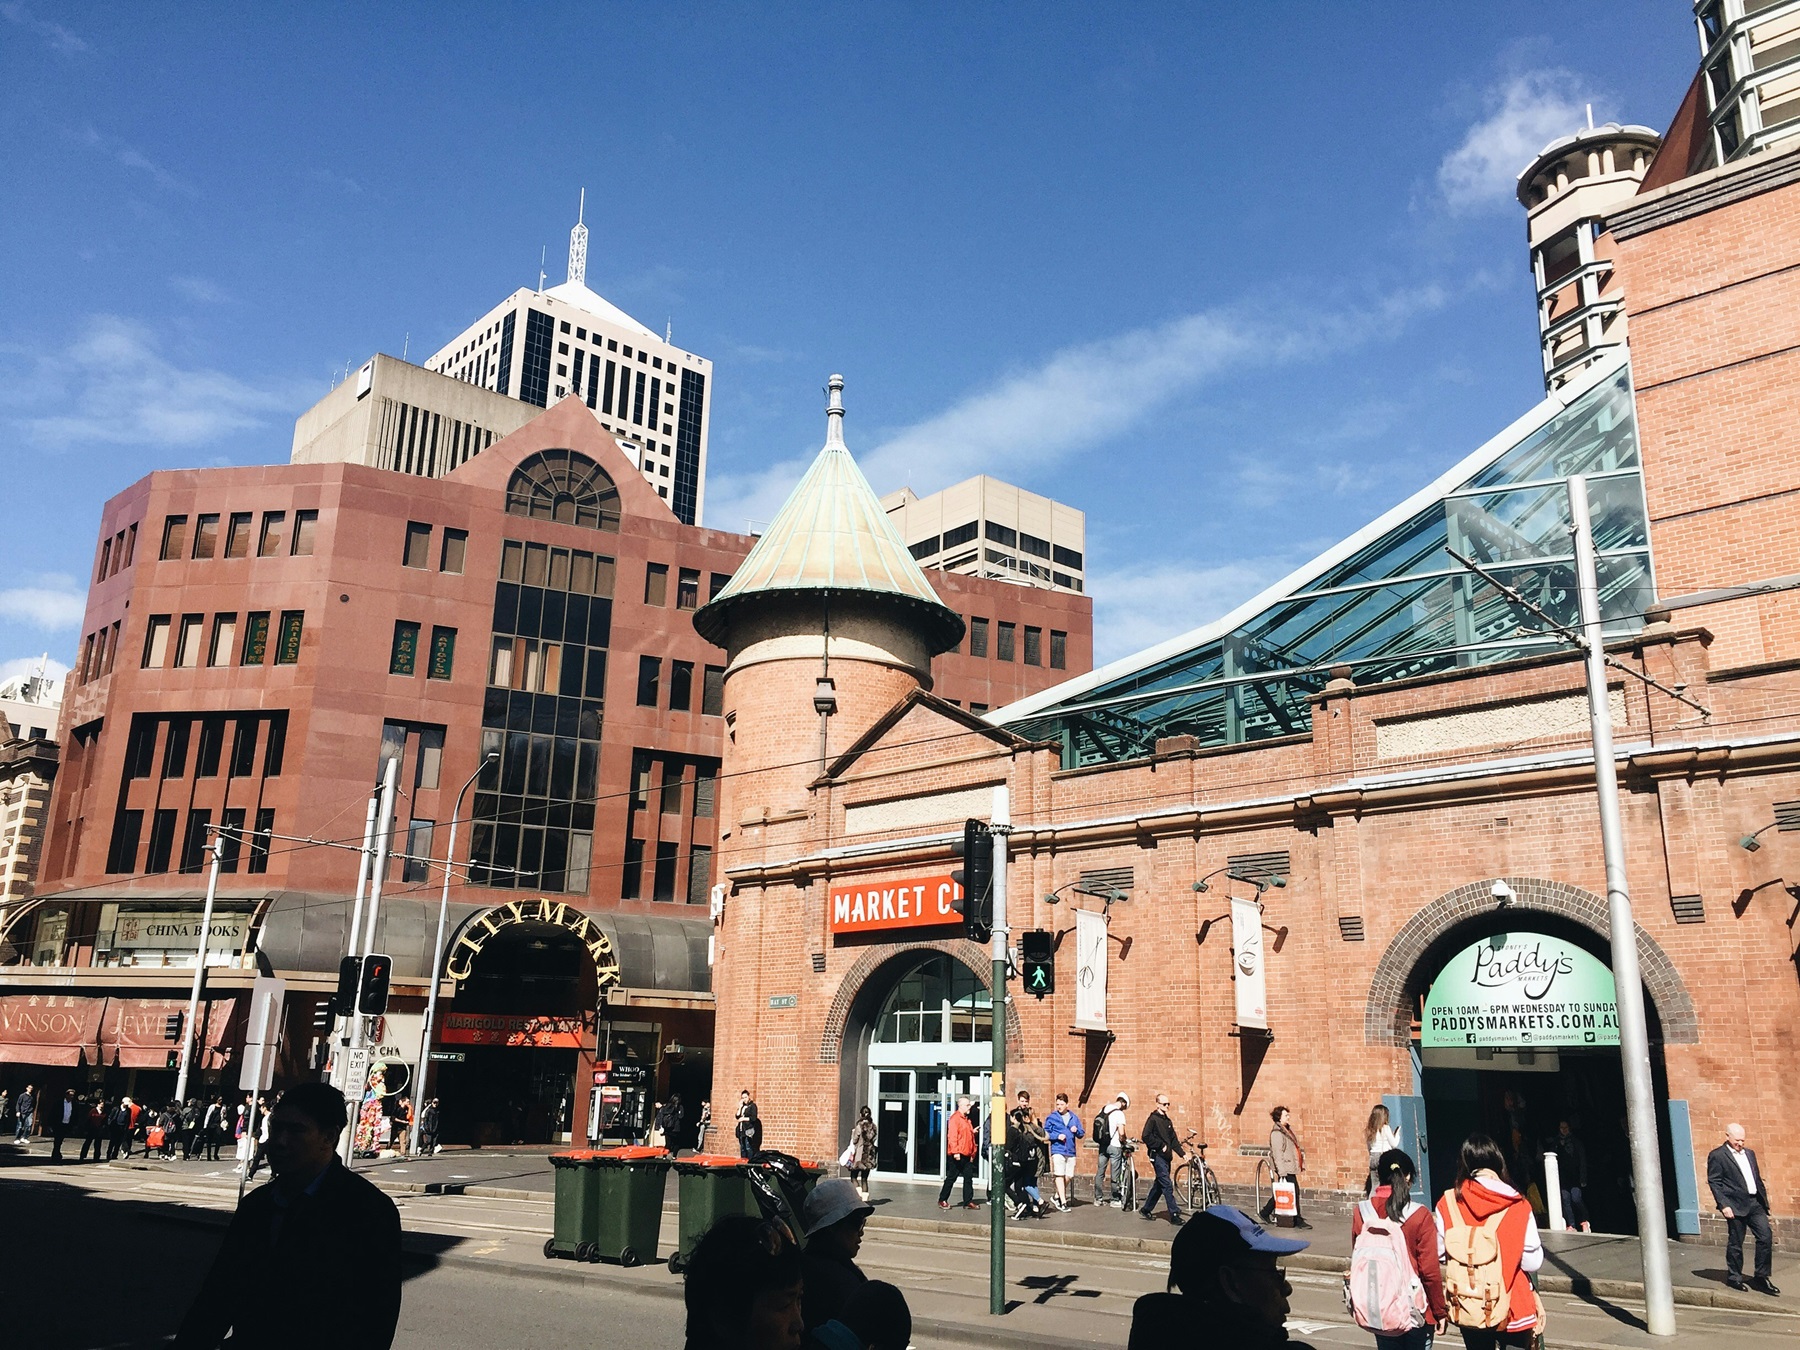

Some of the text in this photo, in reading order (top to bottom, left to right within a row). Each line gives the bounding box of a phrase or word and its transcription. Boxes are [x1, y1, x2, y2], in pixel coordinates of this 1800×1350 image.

[435, 633, 449, 674] ARIGOLD
[834, 882, 960, 925] MARKET CI
[146, 924, 188, 936] CHINA
[193, 925, 240, 937] BOKS
[447, 898, 621, 987] CITYMARK
[1470, 941, 1573, 1000] Paddy's
[1431, 1006, 1453, 1016] OPEN
[1456, 1005, 1480, 1015] 10AM
[1490, 1004, 1509, 1014] 6PM
[1512, 1003, 1566, 1013] WEDNESDAY
[1568, 1003, 1580, 1012] TO
[2, 1004, 85, 1033] VINSON
[446, 1016, 581, 1033] MARIGOLD RESTAURANT
[1432, 1014, 1620, 1030] PADDYSMARKETS.COM.AU
[353, 1051, 364, 1060] NO
[350, 1061, 365, 1069] EXIT
